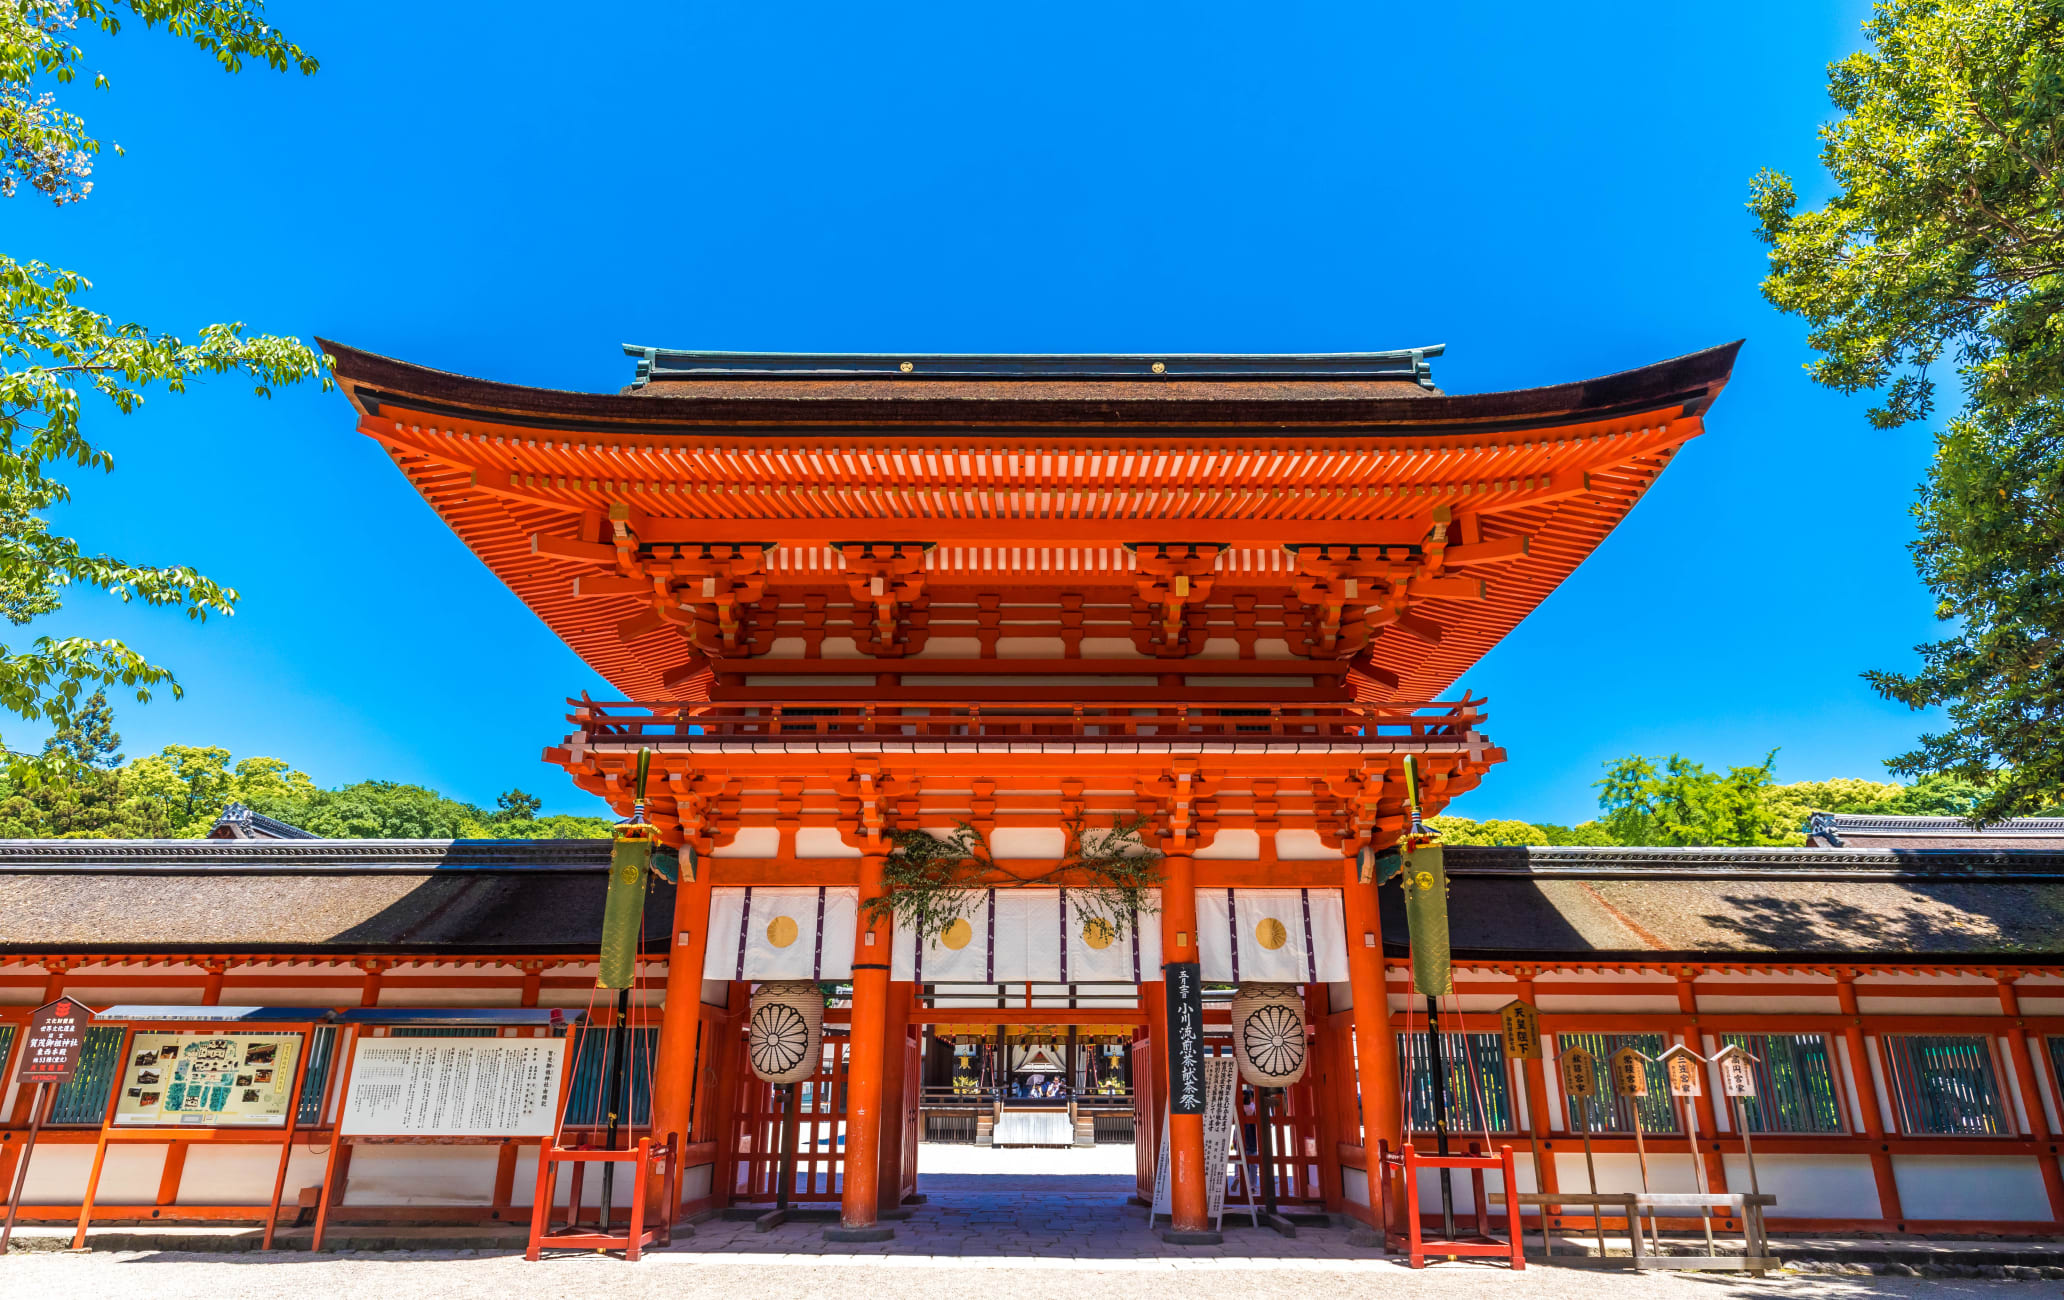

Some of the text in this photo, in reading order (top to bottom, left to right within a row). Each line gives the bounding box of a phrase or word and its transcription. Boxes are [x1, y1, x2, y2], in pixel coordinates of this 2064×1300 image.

[30, 1038, 78, 1048] 賀茂御祖神社
[1514, 1007, 1528, 1054] 天皇陛下
[1177, 1002, 1202, 1110] 小川流煎茶献茶祭
[1678, 1055, 1691, 1092] 三笠宮家
[1732, 1054, 1745, 1092] 高円宮家
